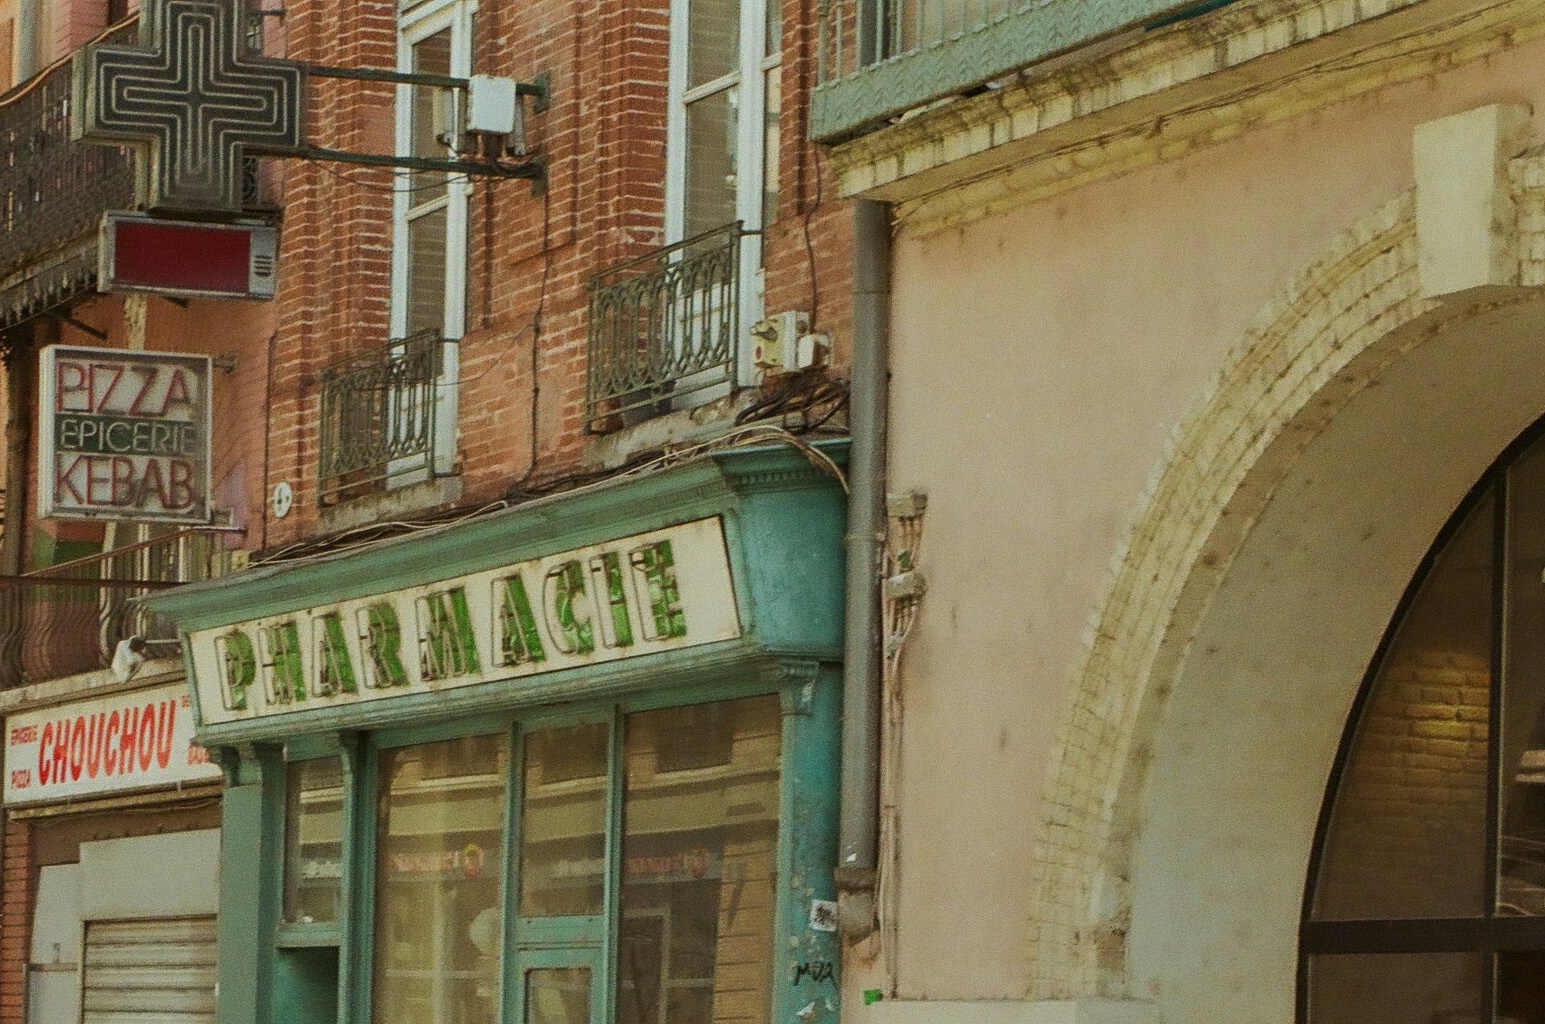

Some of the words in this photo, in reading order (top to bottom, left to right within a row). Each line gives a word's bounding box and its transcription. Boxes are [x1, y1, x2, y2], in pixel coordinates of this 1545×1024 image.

[56, 362, 192, 418] PIZZA
[60, 419, 201, 452] EPICERIE
[56, 453, 194, 510] KEBAB
[214, 539, 688, 711] PHARMACIE
[38, 700, 177, 786] CHOUCHOU
